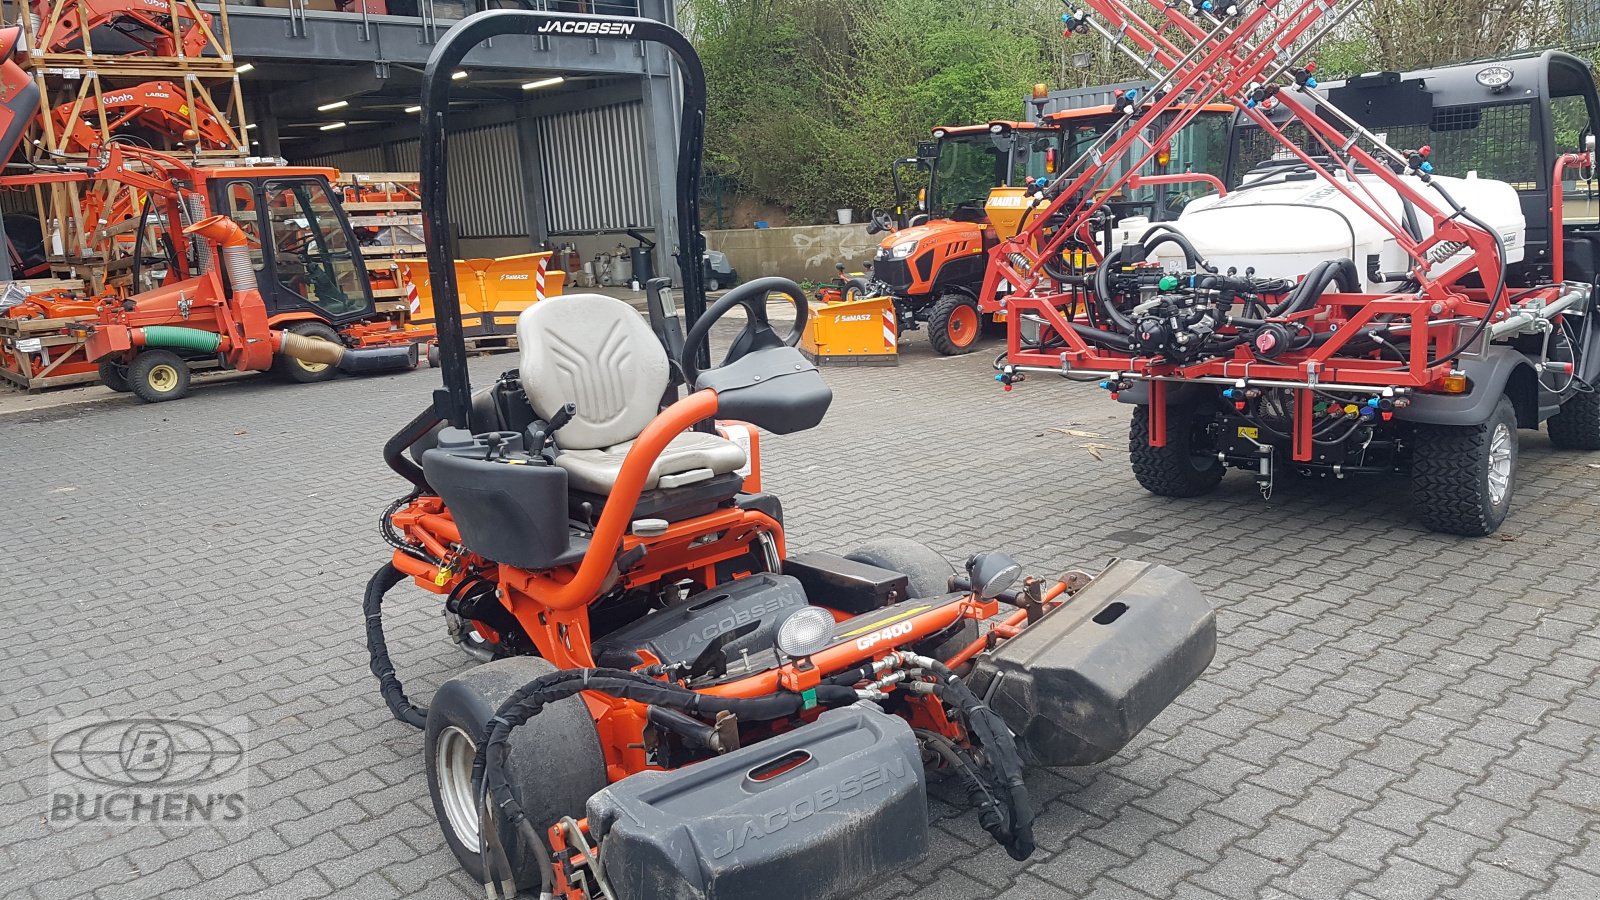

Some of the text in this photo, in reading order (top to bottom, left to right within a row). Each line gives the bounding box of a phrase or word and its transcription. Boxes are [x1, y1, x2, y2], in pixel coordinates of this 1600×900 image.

[538, 21, 635, 35] JACOBSEN
[841, 314, 871, 322] SaMASZ
[670, 593, 797, 656] JACOBSEN
[856, 620, 913, 651] GP400
[713, 758, 905, 859] JACOBSEN
